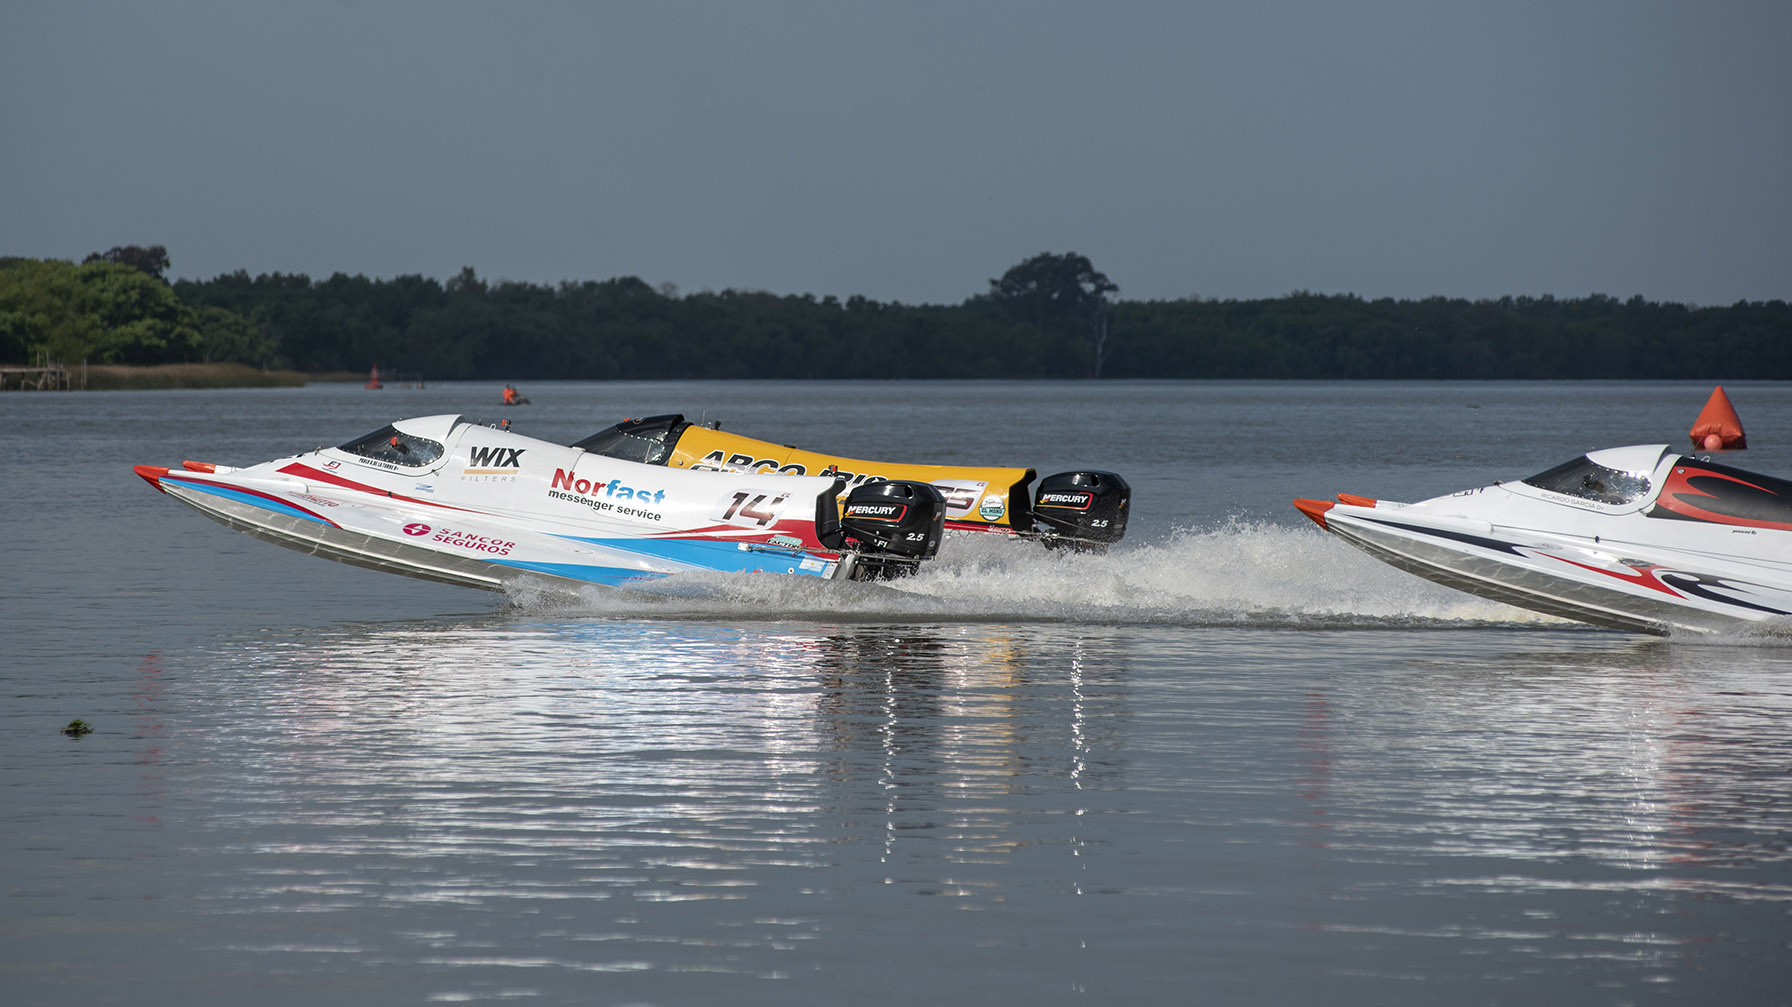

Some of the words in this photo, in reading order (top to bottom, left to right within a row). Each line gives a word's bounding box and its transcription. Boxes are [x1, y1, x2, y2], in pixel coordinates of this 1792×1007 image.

[470, 446, 526, 468] WIX
[461, 475, 517, 483] FILTERS
[551, 467, 666, 504] Norfast
[1041, 493, 1090, 504] MERCURY
[1541, 492, 1570, 503] RICARDO
[548, 489, 615, 511] messenger
[616, 505, 662, 521] service
[846, 505, 897, 515] MERCURY
[1091, 519, 1109, 528] 2.5
[439, 527, 516, 549] SANCOR
[906, 532, 925, 542] 2.5
[432, 534, 511, 556] SEGUROS
